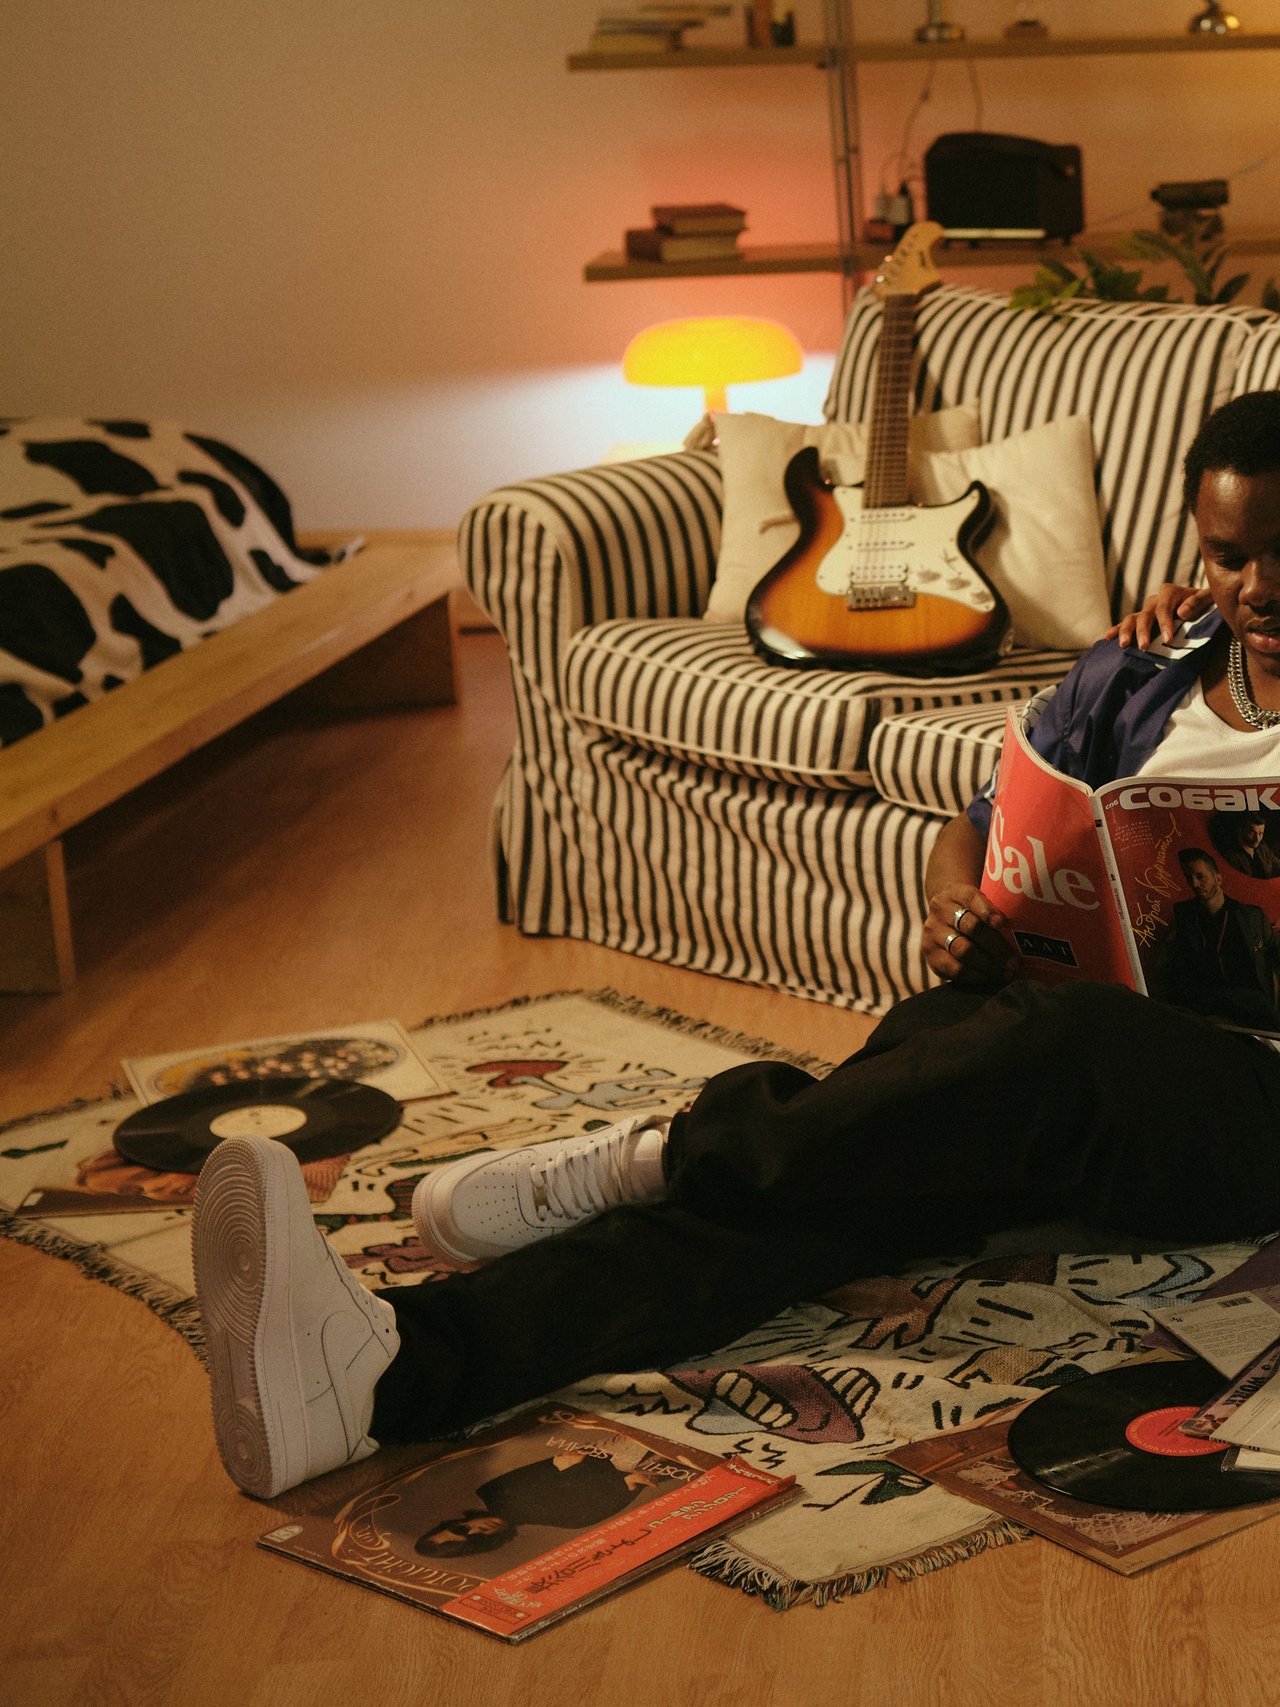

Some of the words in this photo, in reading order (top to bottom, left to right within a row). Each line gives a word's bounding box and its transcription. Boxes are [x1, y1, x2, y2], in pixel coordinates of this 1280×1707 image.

[985, 805, 1100, 911] Sale
[642, 1460, 698, 1483] YOSHI
[349, 1548, 484, 1593] POTLIGHT
